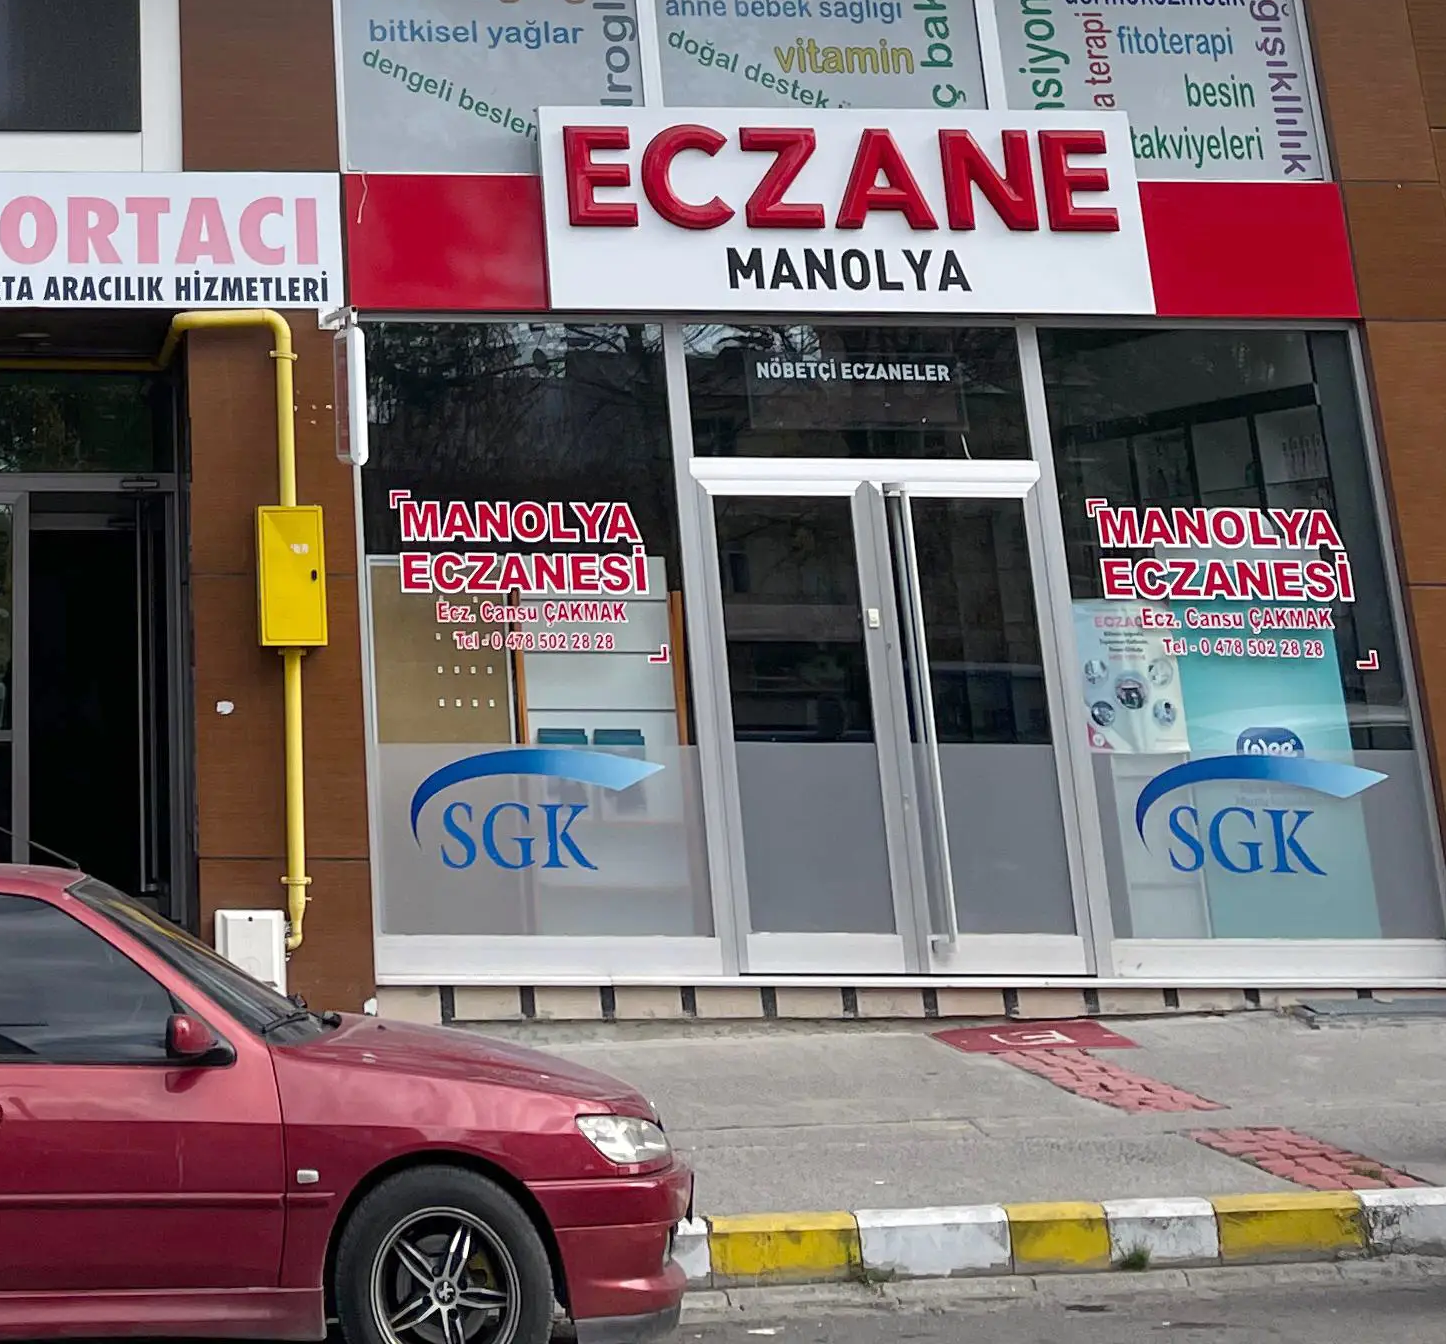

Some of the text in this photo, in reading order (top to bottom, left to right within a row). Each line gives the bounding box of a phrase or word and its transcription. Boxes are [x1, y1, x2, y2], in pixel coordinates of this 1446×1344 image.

[369, 19, 584, 49] bitkisel yağlar
[773, 37, 914, 73] vitamin
[1116, 25, 1234, 61] fitoterapi
[363, 49, 453, 102] dengeli
[668, 30, 830, 109] doğal destek
[1184, 74, 1255, 108] besin
[563, 124, 1120, 232] ECZANE
[44, 276, 164, 302] ARACILIK
[175, 271, 329, 303] HİZMETLERİ
[728, 247, 972, 292] MANOLYA
[756, 358, 950, 381] NÖBETÇİ ECZANELER
[401, 501, 643, 543] MANOLYA
[1097, 507, 1344, 550] MANOLYA
[400, 544, 649, 594] ECZANESİ
[1100, 552, 1355, 602] ECZANESİ
[436, 601, 628, 626] Ecz. Cansu ÇAKMAK
[1142, 607, 1335, 634] Ecz. Cansu ÇAKMAK
[1163, 638, 1187, 655] Tel
[1214, 639, 1243, 656] 478
[1248, 639, 1276, 656] 502
[1280, 640, 1299, 657] 28
[1305, 640, 1324, 658] 28
[440, 801, 598, 870] SGK
[1168, 805, 1328, 876] SGK
